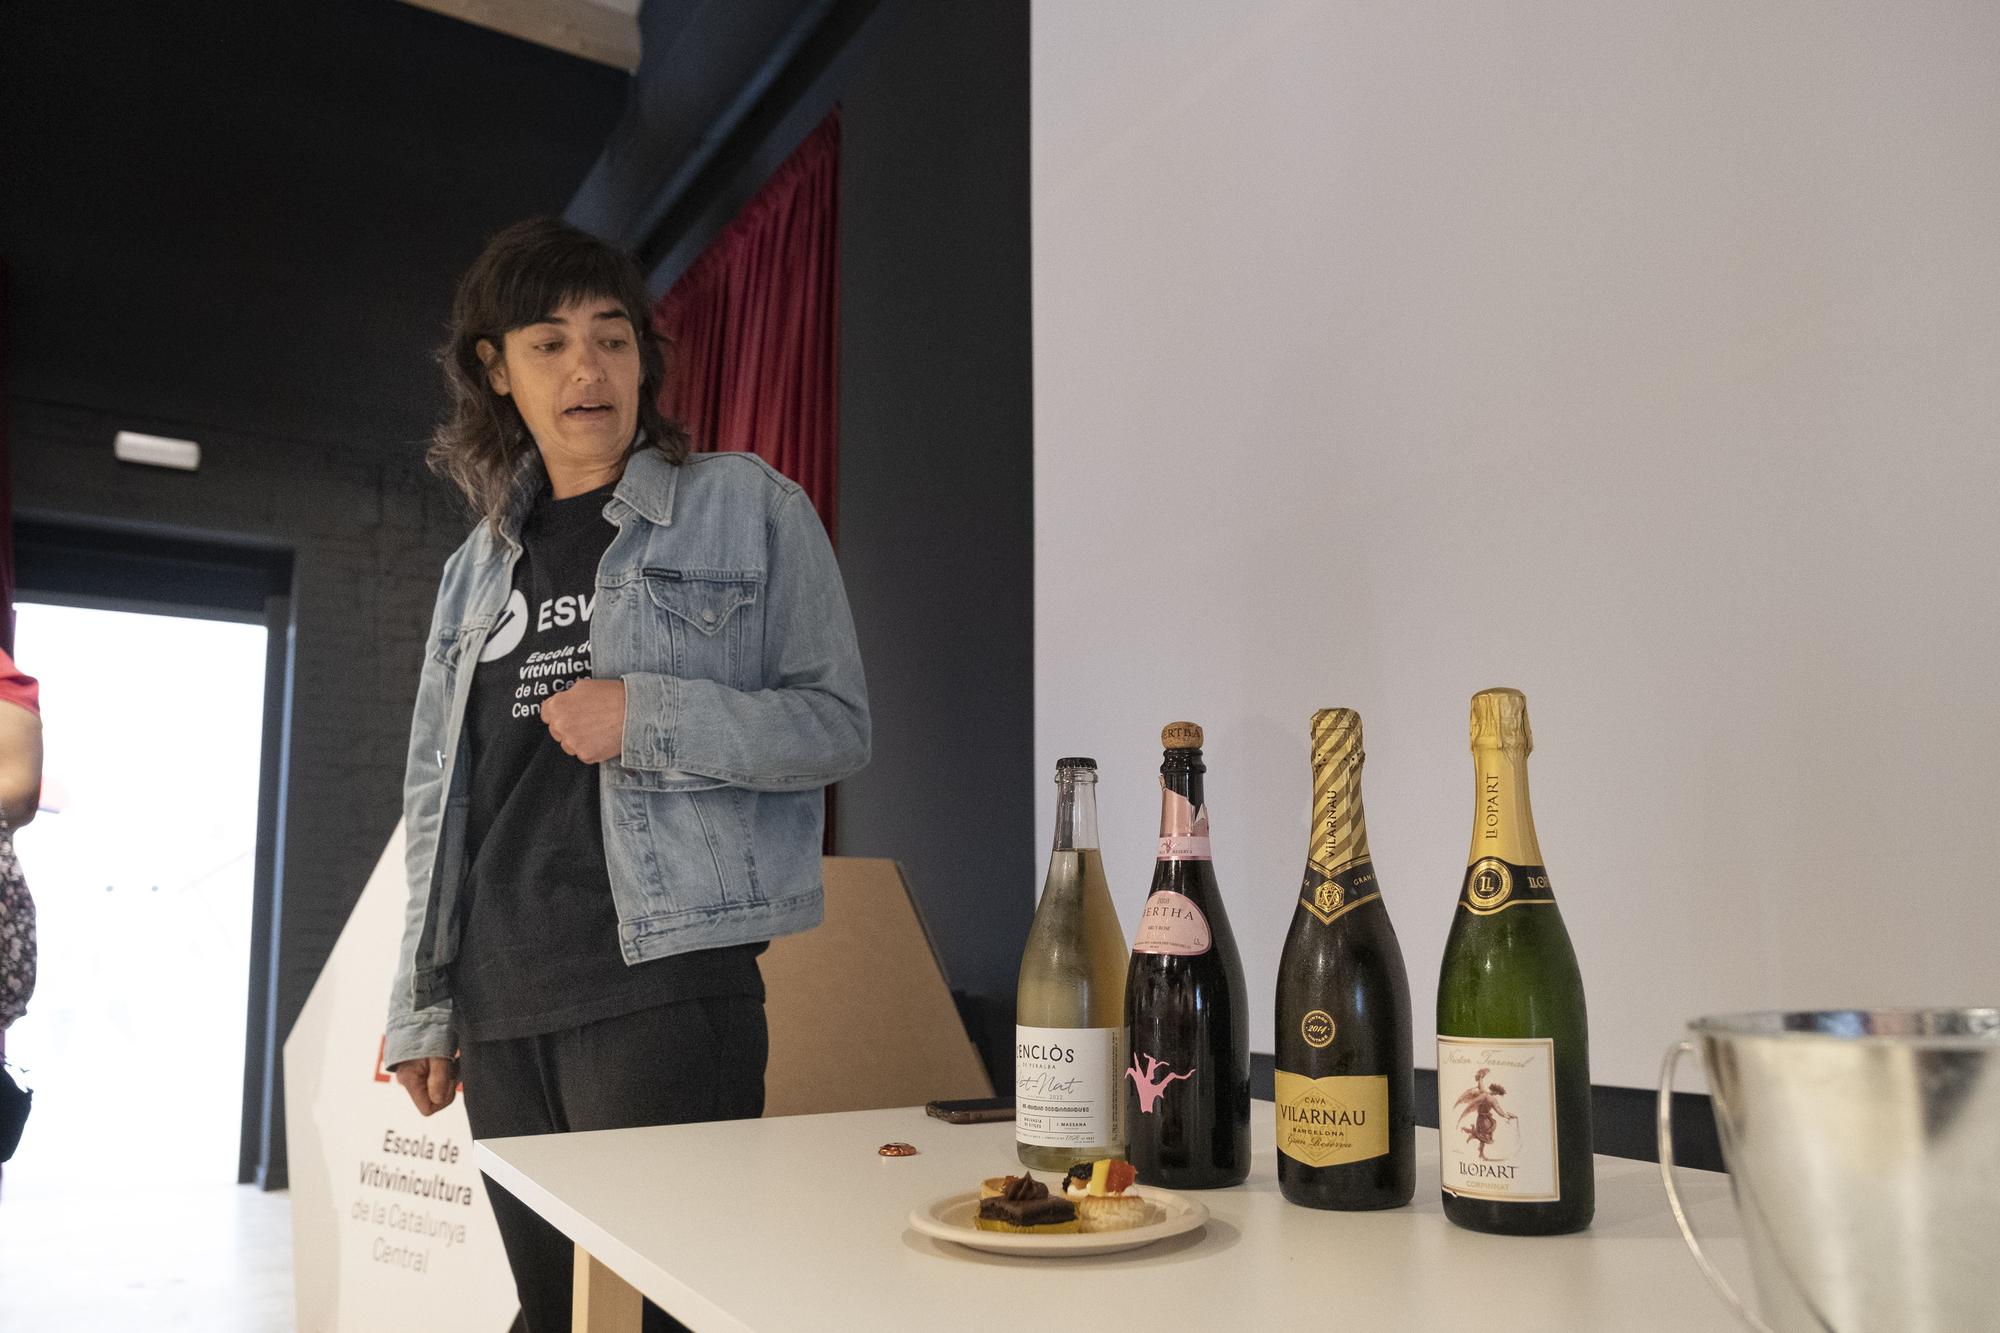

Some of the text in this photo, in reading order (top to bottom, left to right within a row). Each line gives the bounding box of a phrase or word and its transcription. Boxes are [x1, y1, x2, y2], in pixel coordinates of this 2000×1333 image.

[526, 646, 575, 663] Escola
[515, 684, 531, 699] de
[534, 682, 549, 696] la
[1326, 790, 1337, 861] VILARNAU
[1307, 1025, 1328, 1034] 2014
[1304, 1097, 1326, 1105] CAVA
[1281, 1104, 1366, 1126] VILARNAU
[1293, 1127, 1344, 1137] BARCELONA
[382, 1129, 460, 1164] Escola de
[359, 1160, 473, 1206] Vitivinicultura
[351, 1198, 467, 1248] de la Catalunya
[373, 1236, 429, 1274] Central
